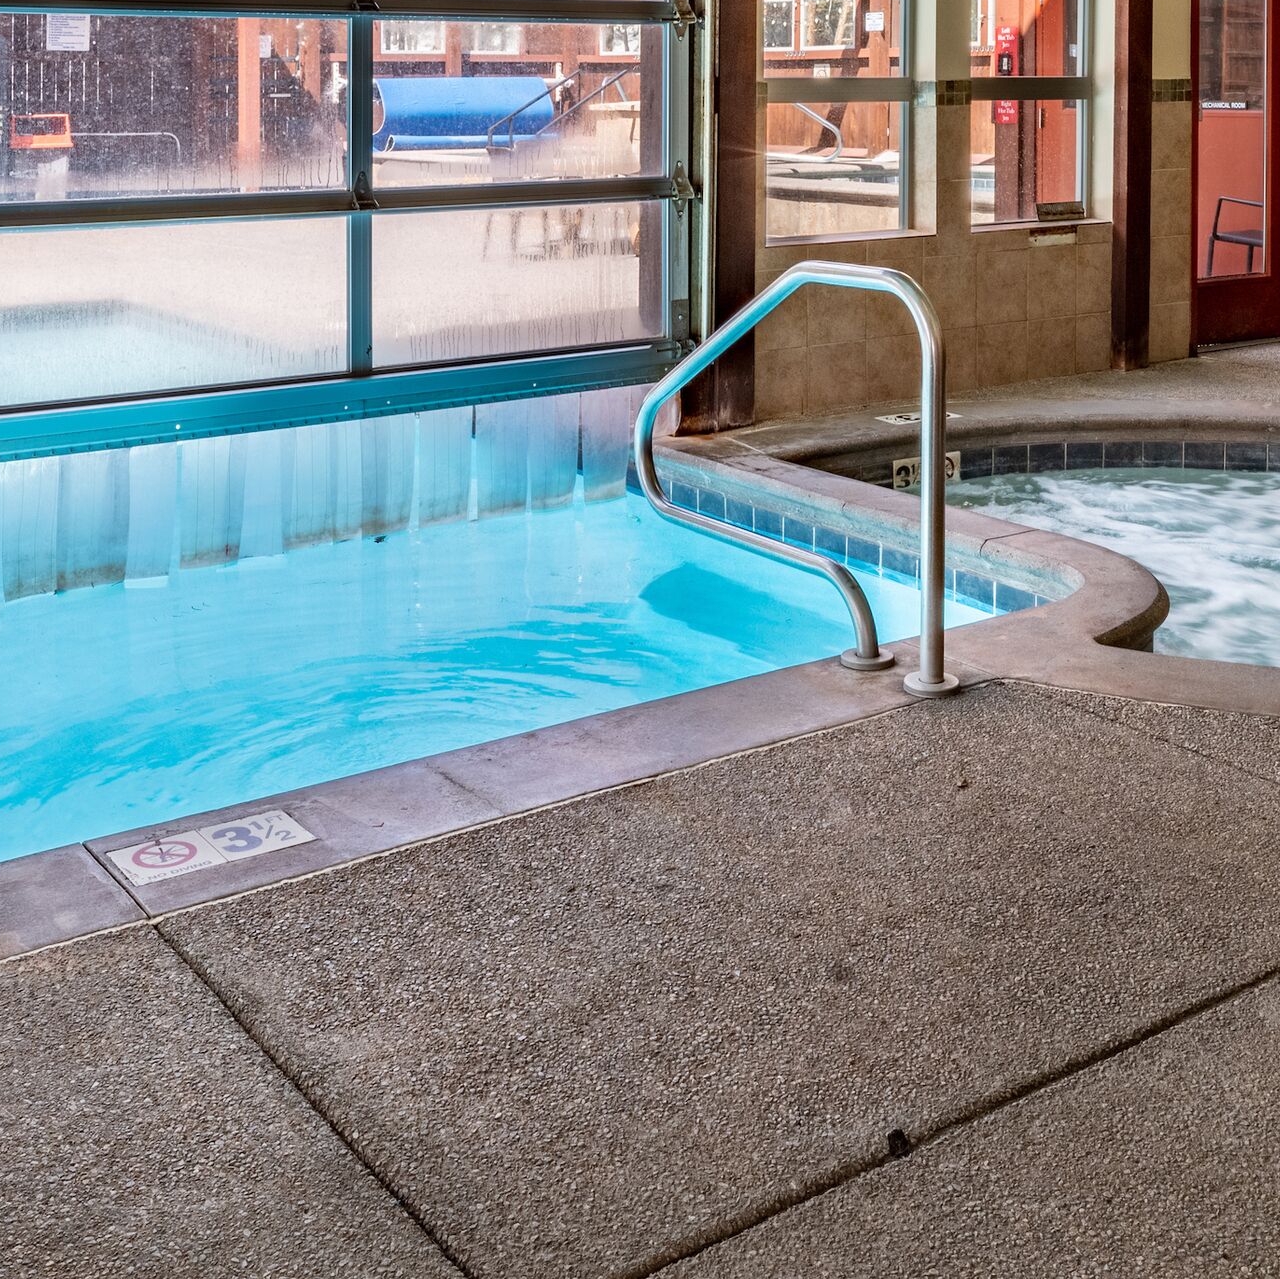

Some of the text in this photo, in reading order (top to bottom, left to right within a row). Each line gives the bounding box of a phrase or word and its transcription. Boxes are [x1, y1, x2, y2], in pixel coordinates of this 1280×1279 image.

[896, 465, 911, 488] 3
[264, 814, 283, 824] FT
[148, 860, 213, 881] NO DIVING
